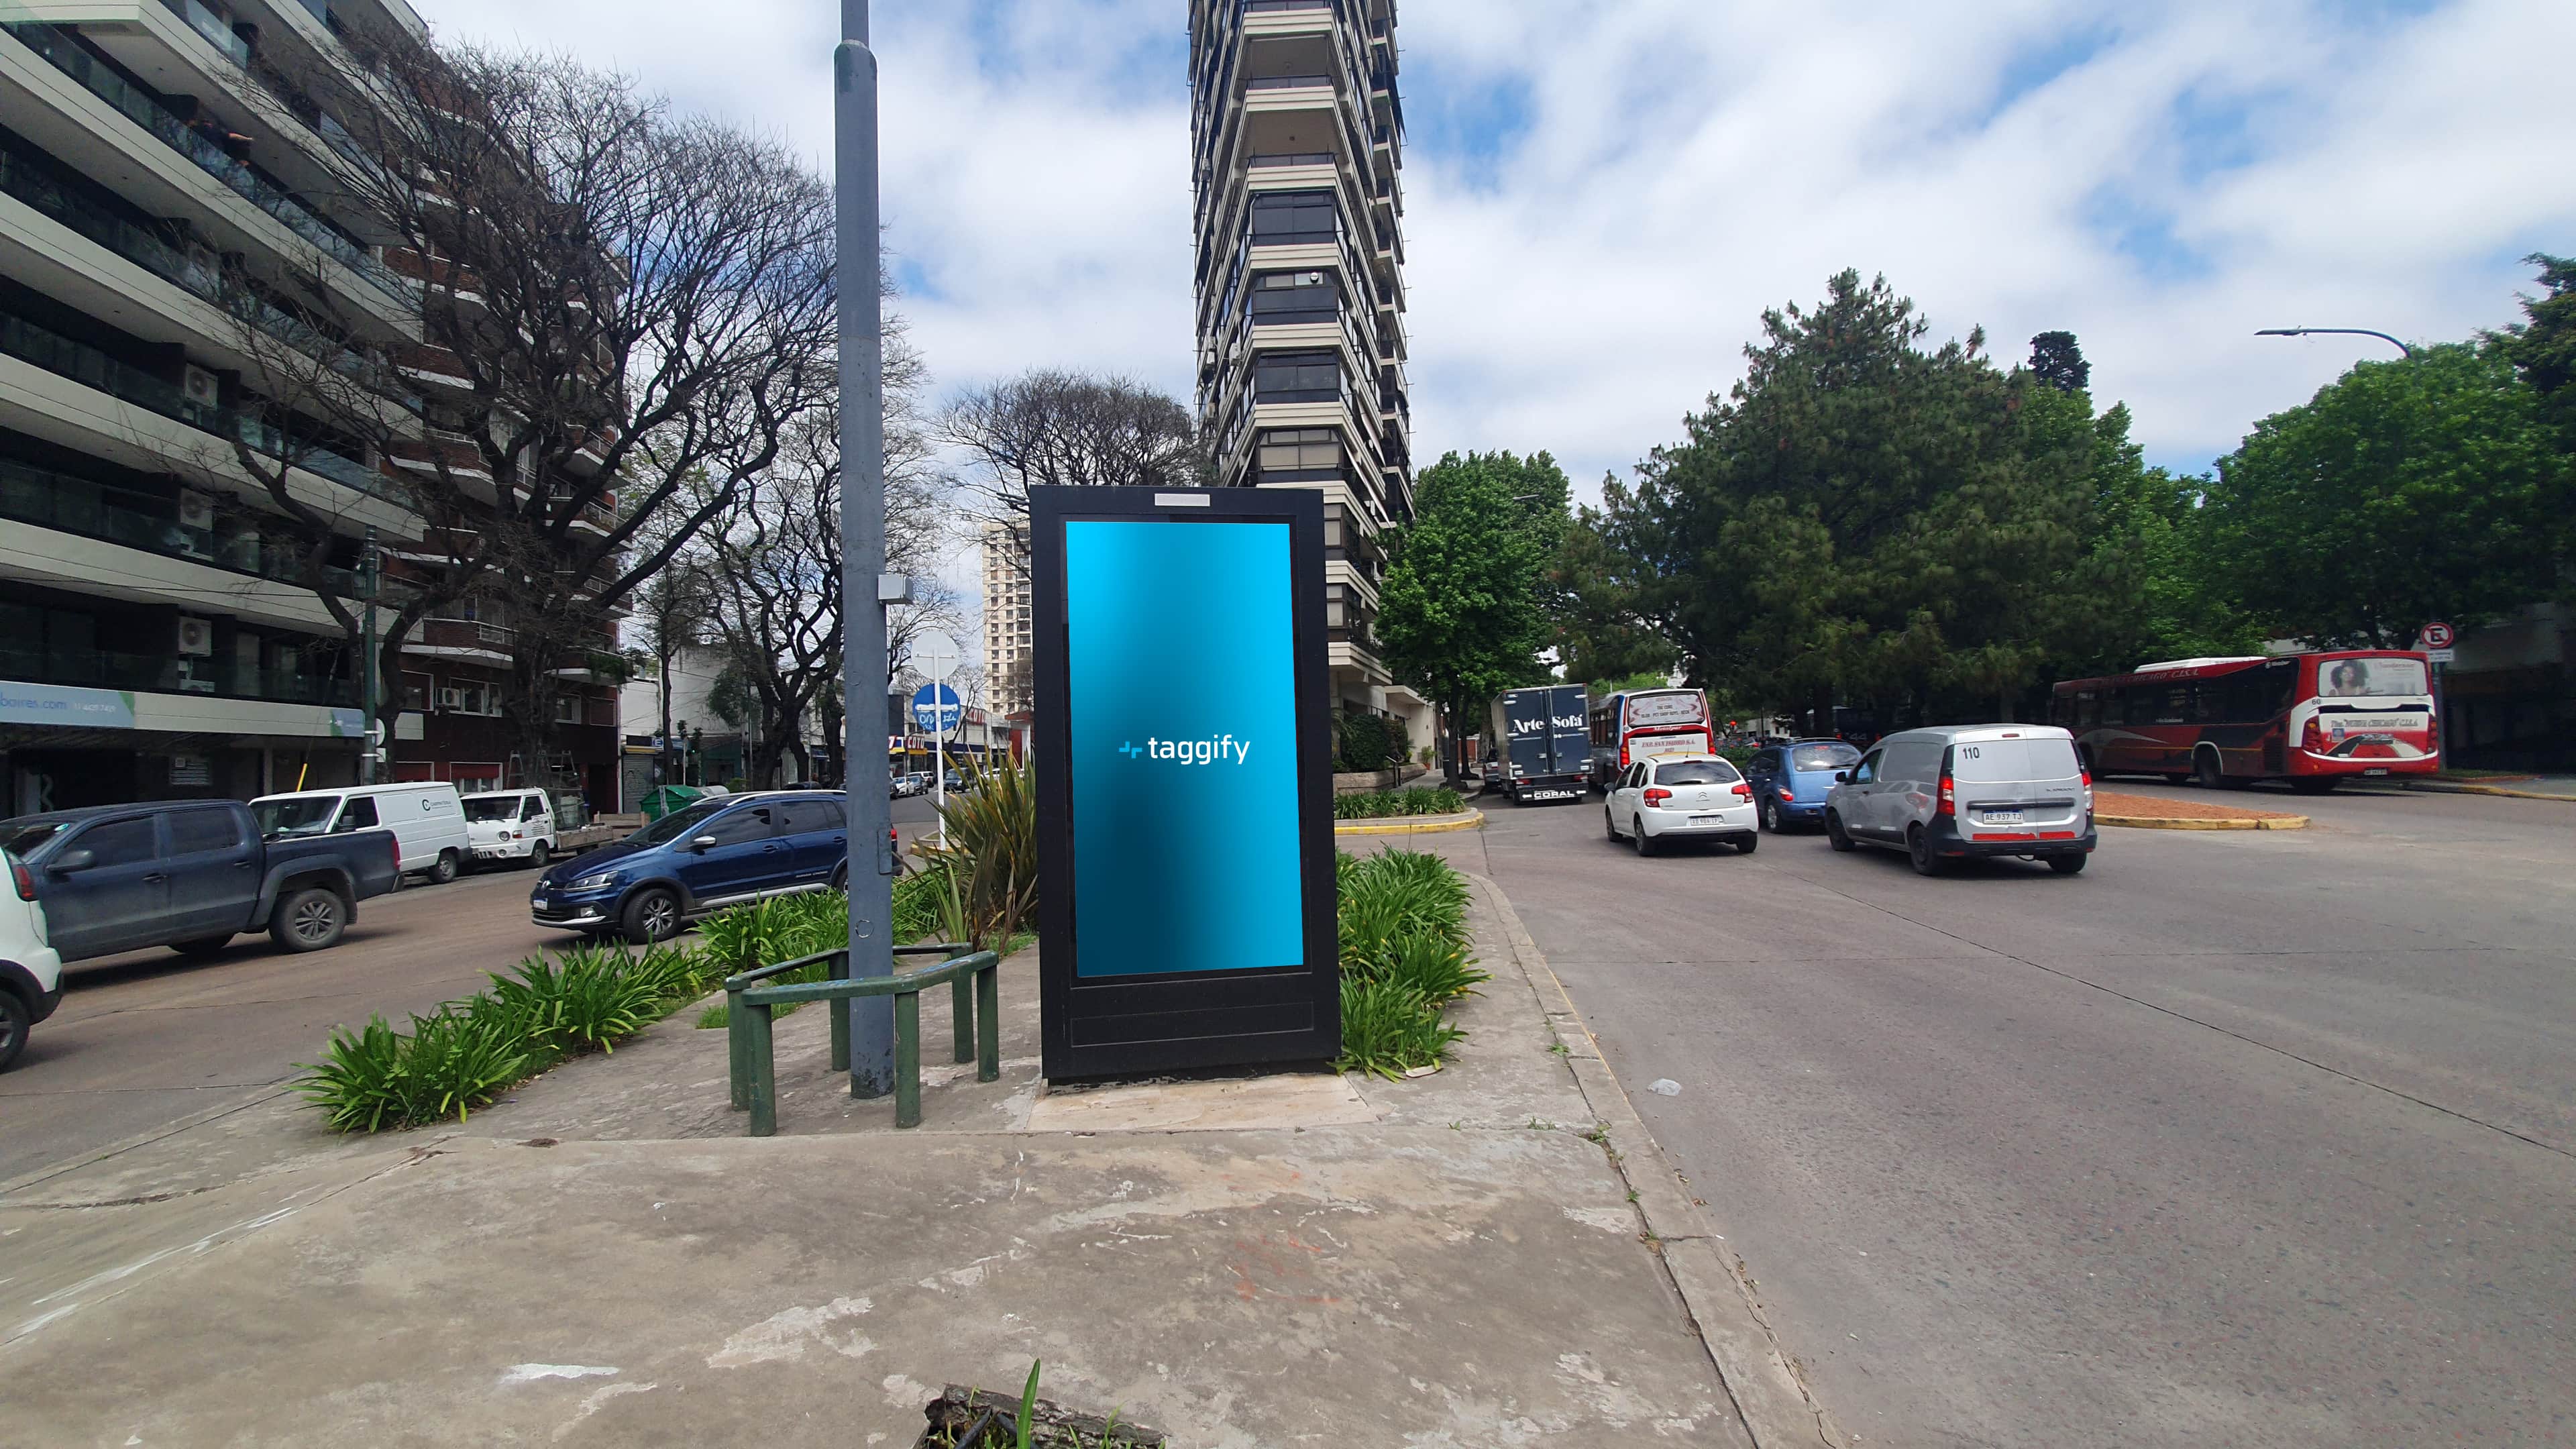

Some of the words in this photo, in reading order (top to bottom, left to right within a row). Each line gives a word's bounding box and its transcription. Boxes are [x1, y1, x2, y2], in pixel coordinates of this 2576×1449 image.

[1513, 718, 1544, 733] Arte
[1552, 714, 1583, 728] Sofá
[908, 736, 925, 749] COTO
[1148, 734, 1250, 765] taggify
[1963, 747, 1980, 759] 110
[1534, 790, 1575, 798] CORAL
